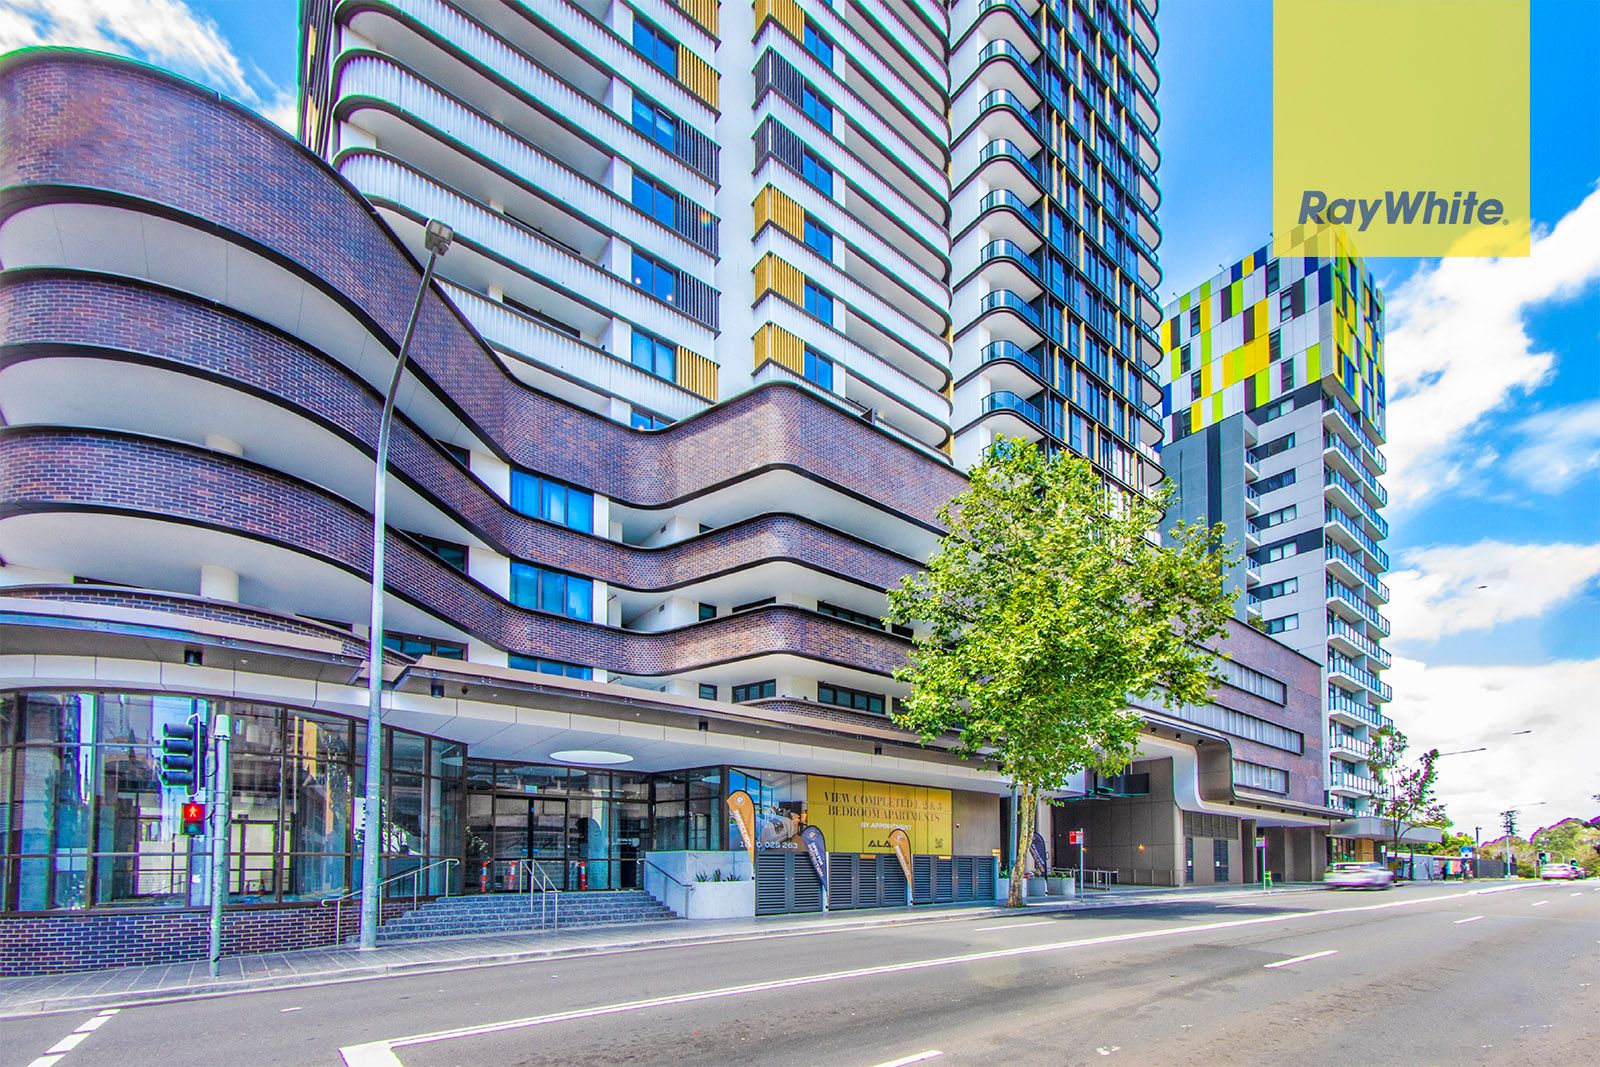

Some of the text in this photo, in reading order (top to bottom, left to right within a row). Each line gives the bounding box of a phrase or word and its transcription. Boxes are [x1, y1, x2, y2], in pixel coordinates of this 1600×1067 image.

[825, 791, 850, 803] VIEW
[854, 794, 914, 808] COMPLETED
[828, 805, 940, 822] BEDROOM APARTMENTS
[870, 822, 912, 831] APPOINTMENT
[868, 839, 893, 848] ALA
